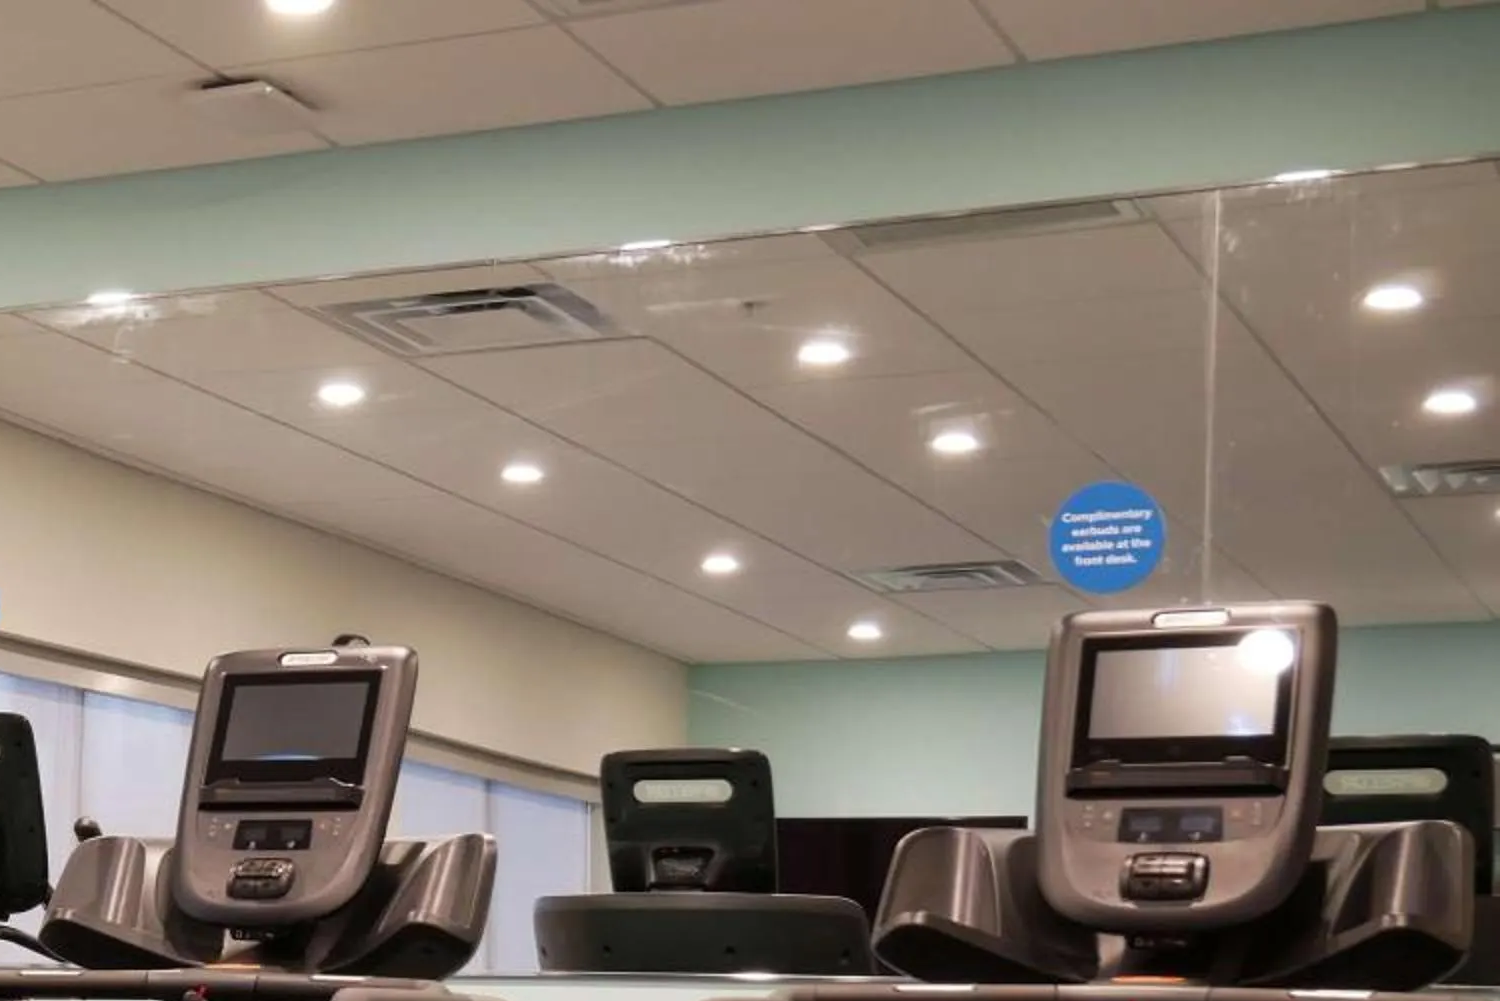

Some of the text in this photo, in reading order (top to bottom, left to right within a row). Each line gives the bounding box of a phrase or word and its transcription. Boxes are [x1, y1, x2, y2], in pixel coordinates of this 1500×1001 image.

[1061, 509, 1153, 523] Complimentary
[1071, 525, 1142, 537] earbuds are
[1061, 538, 1152, 553] available at the
[1074, 555, 1104, 566] front
